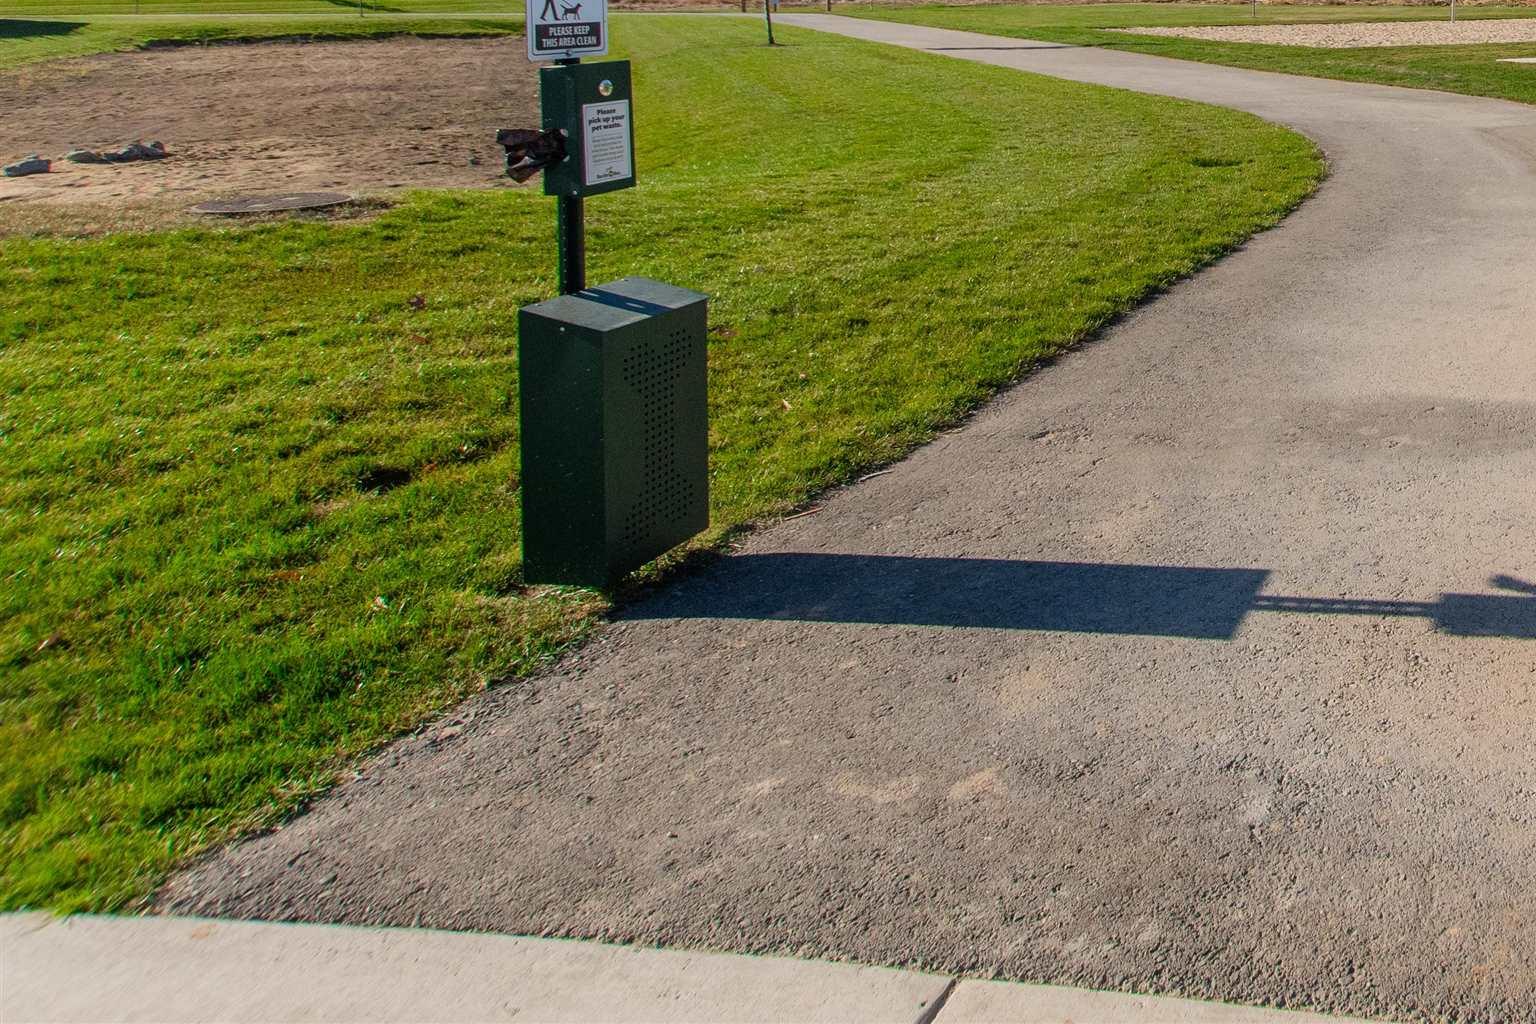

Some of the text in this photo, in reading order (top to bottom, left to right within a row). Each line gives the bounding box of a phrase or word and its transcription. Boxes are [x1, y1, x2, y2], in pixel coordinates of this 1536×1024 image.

[549, 26, 590, 36] PLEASE KEEP
[542, 36, 597, 48] THIS AREA CLEAN
[588, 116, 602, 125] pick
[612, 114, 625, 122] your
[591, 125, 602, 133] pet
